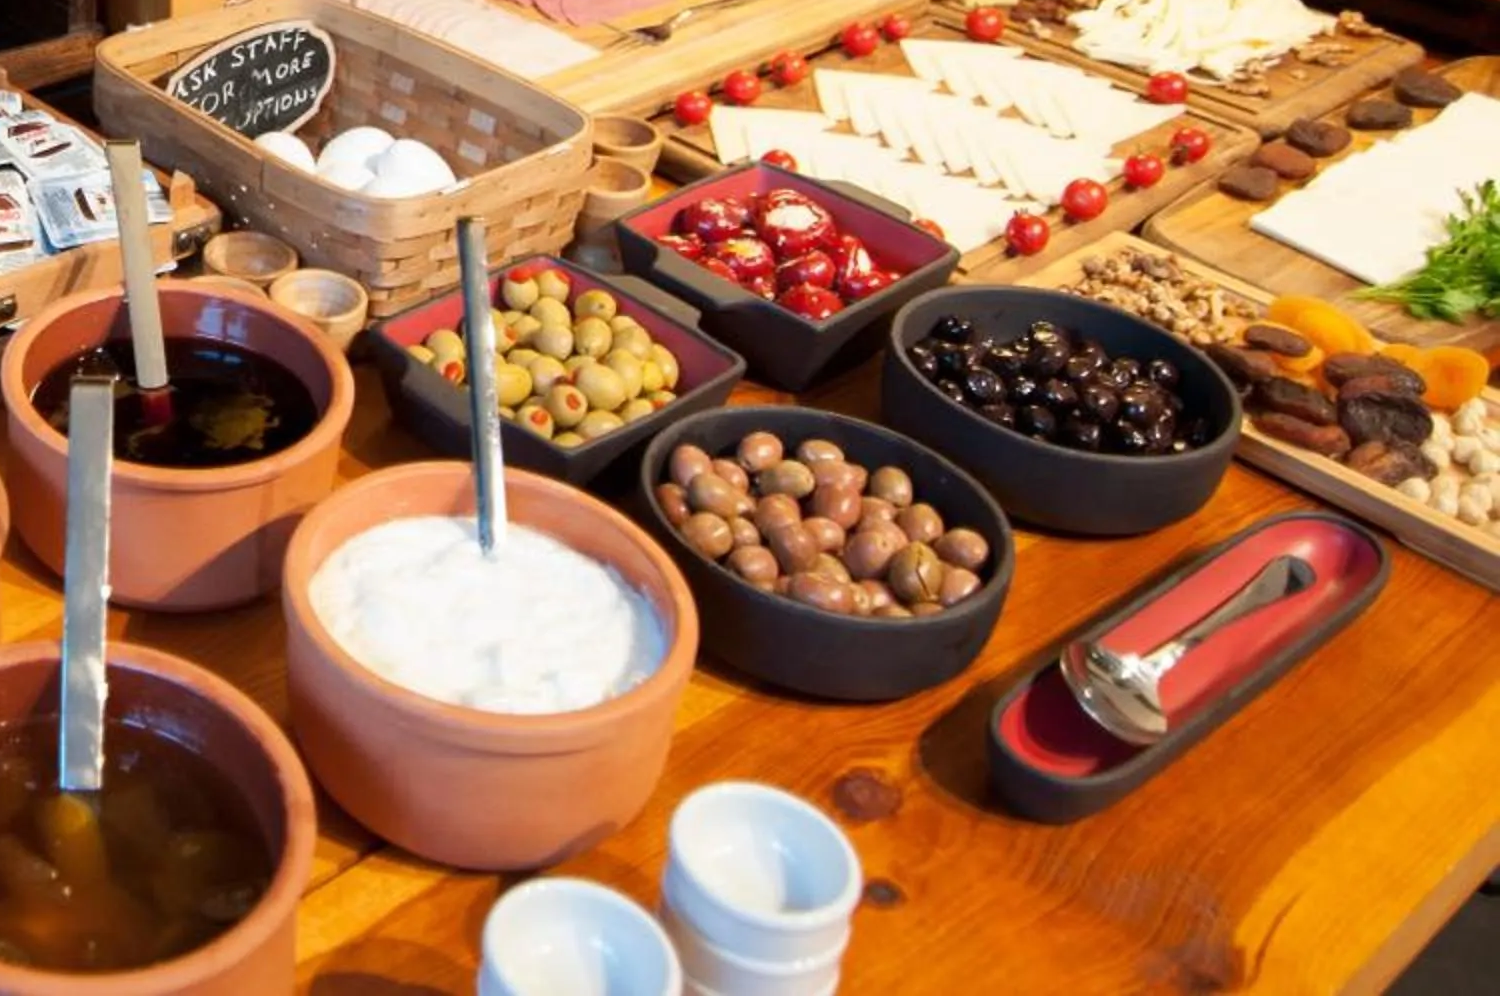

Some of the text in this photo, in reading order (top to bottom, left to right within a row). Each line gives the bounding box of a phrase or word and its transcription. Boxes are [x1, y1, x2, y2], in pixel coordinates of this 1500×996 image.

[176, 28, 308, 99] ASK STAFF
[253, 51, 316, 86] MORE
